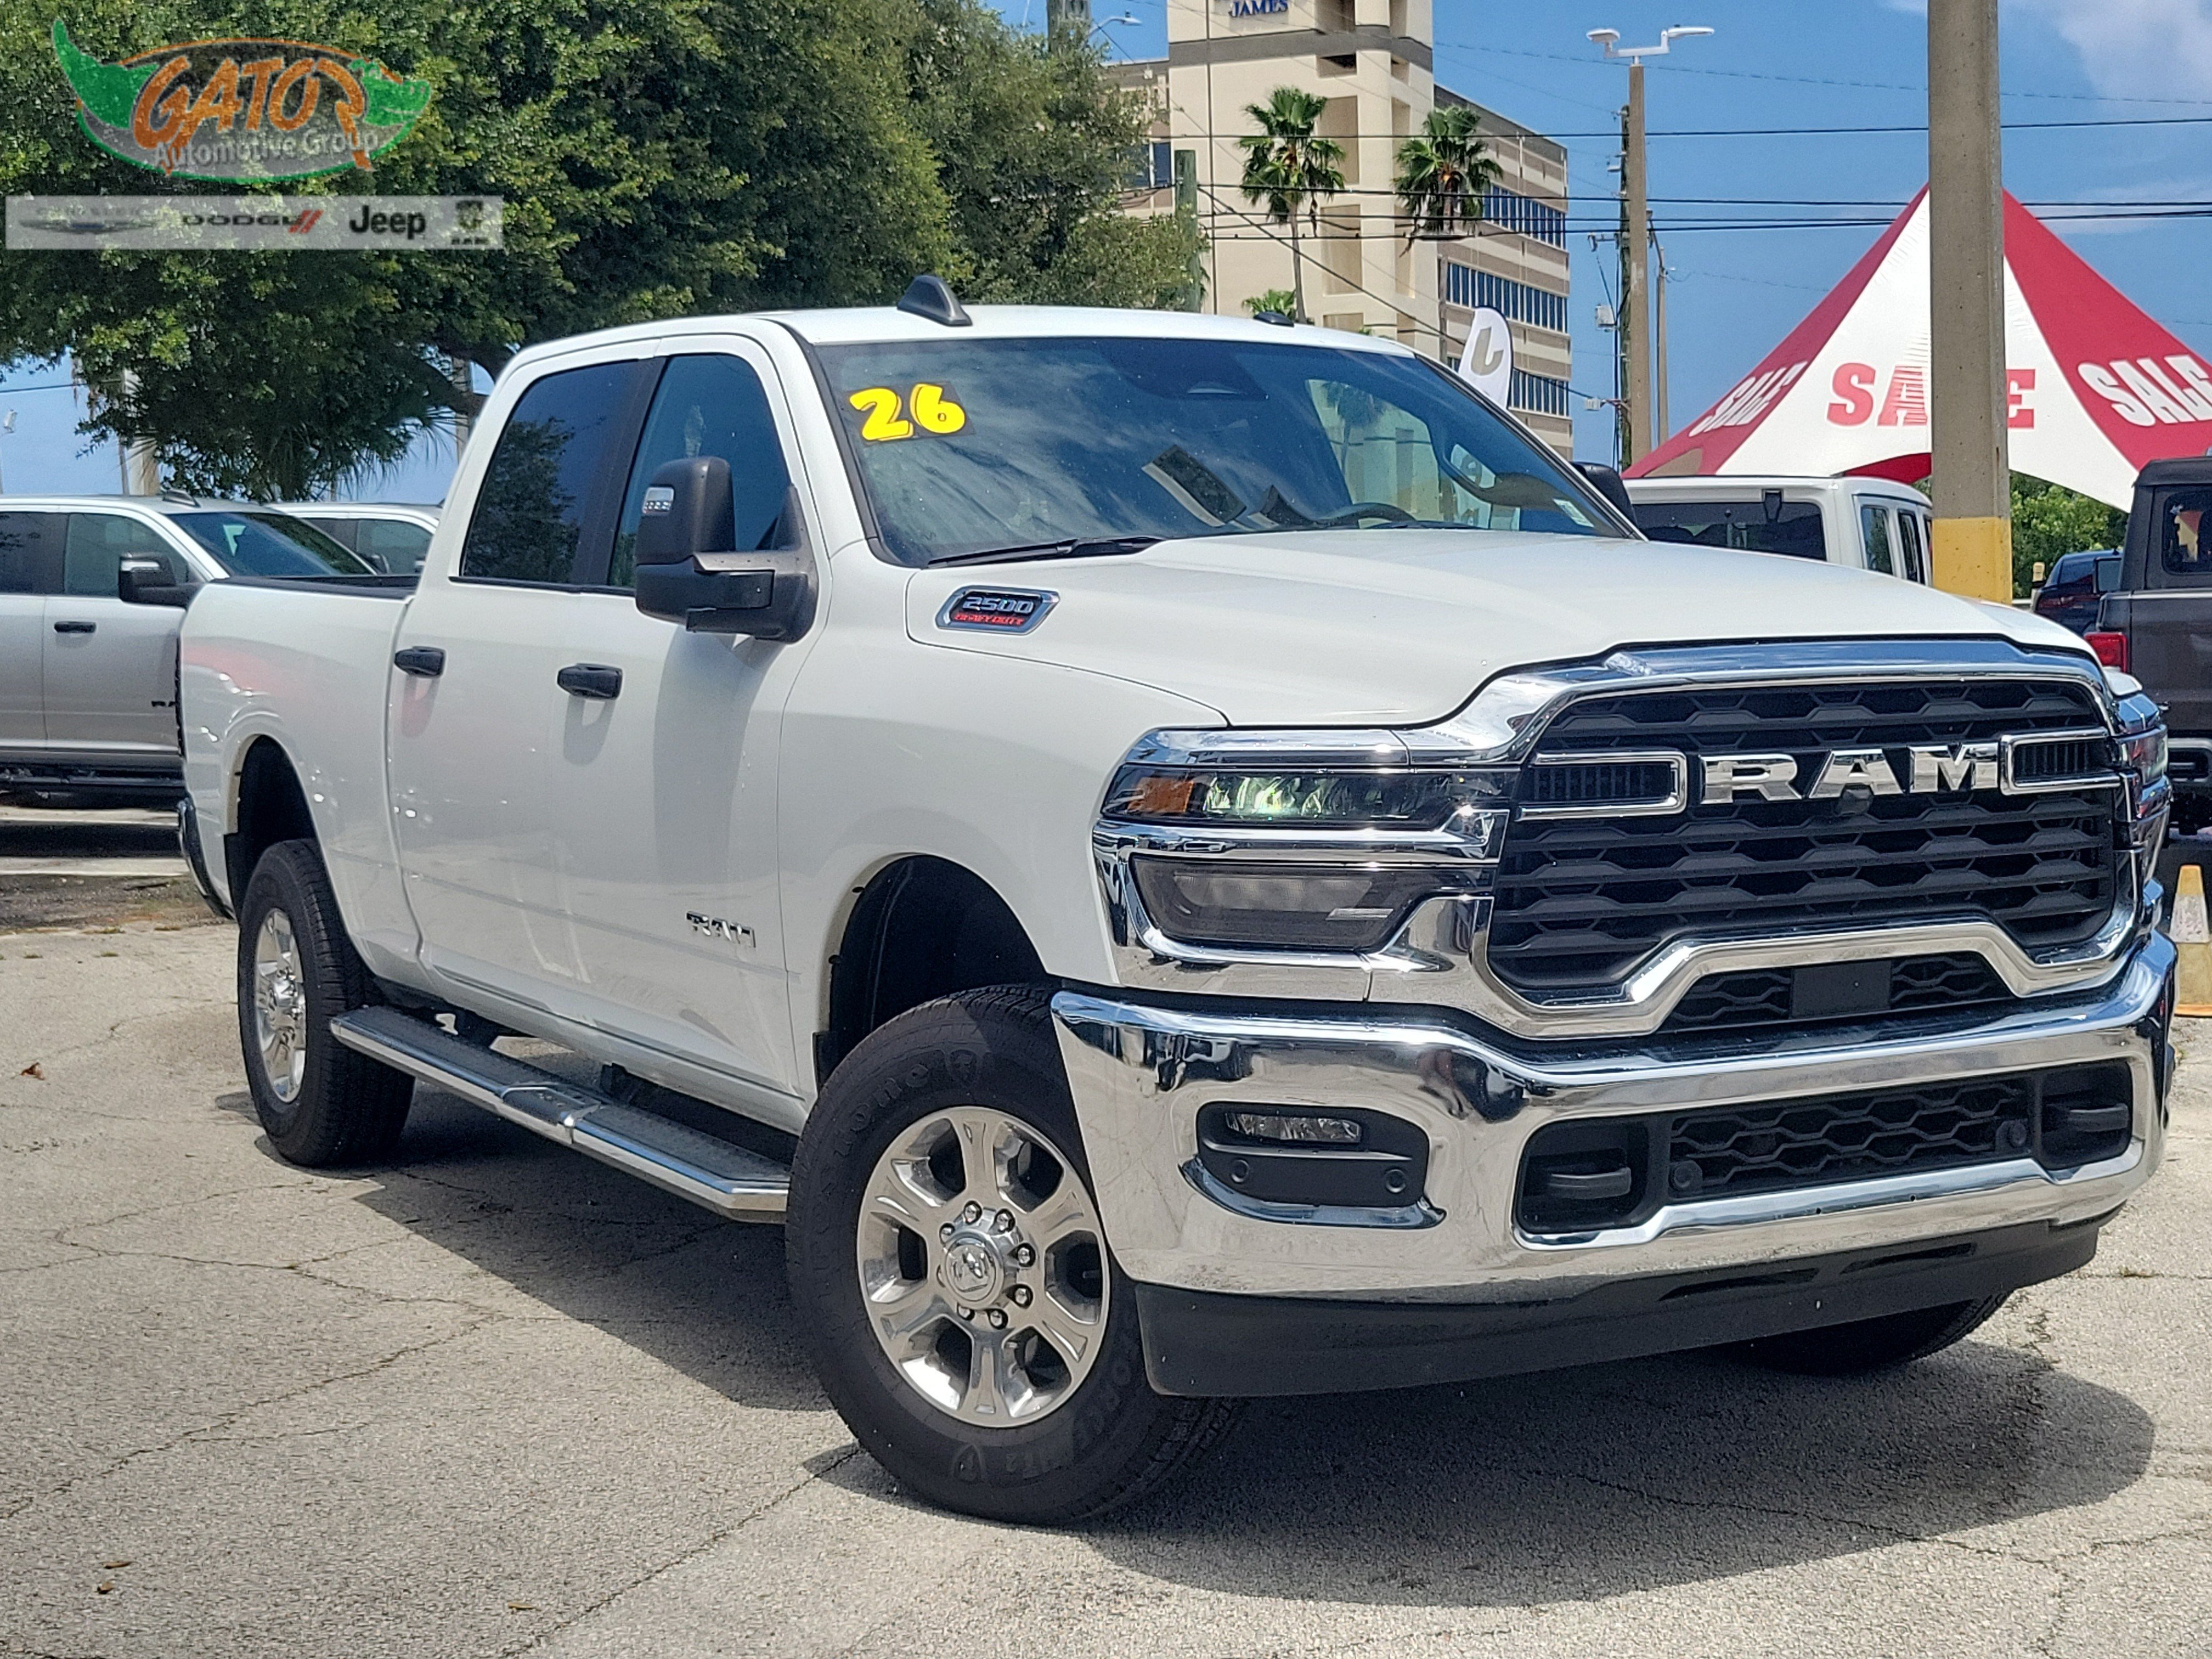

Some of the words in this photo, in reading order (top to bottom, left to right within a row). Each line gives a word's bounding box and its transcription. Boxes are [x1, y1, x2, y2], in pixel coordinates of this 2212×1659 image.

[849, 383, 966, 441] 26
[1689, 360, 1808, 437] SALE
[1826, 362, 2036, 430] SAE
[2077, 354, 2212, 427] SALE
[962, 596, 1034, 614] 2500
[1699, 742, 1997, 805] RAM
[686, 911, 757, 949] RAM
